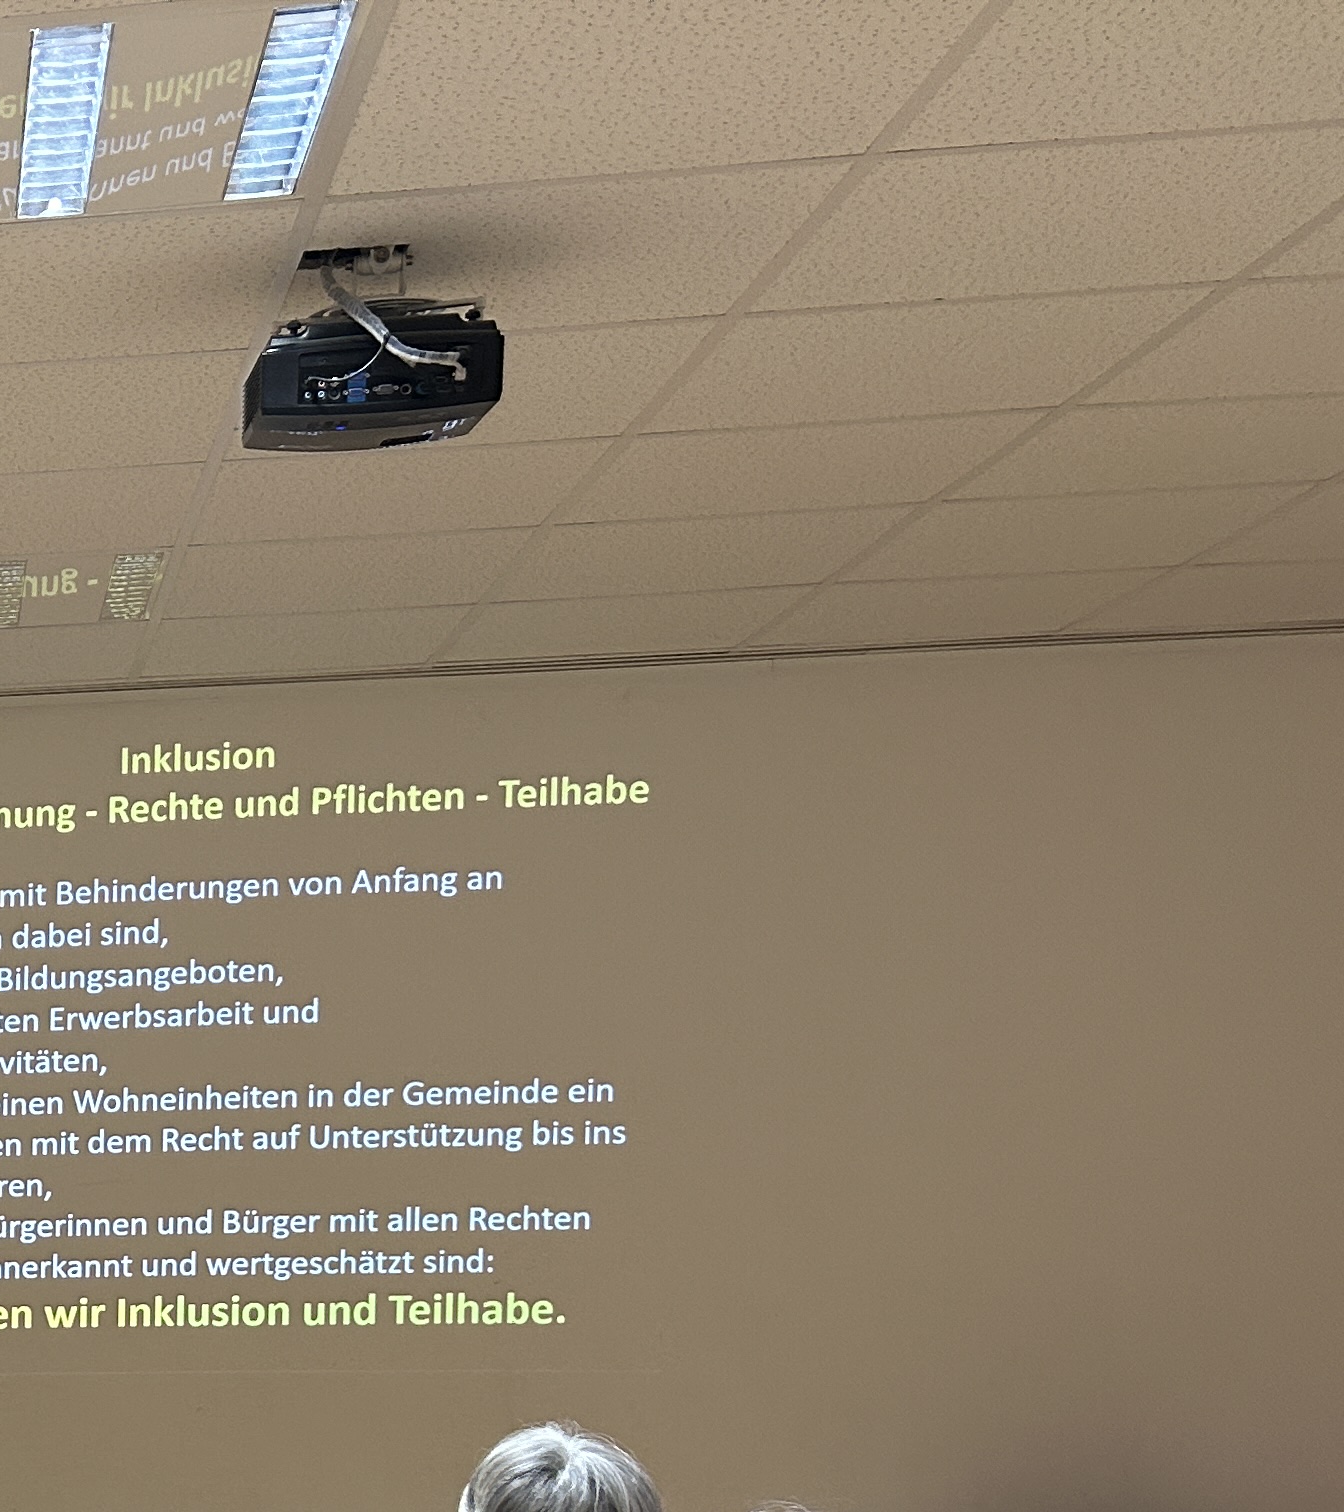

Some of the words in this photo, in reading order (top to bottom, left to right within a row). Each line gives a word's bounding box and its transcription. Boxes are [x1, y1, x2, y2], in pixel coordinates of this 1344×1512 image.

[121, 741, 276, 775] Inklusion
[108, 791, 224, 824] Rechte
[234, 786, 300, 819] und
[311, 782, 465, 816] Pflichten
[497, 773, 650, 809] Teilhabe
[0, 882, 48, 908] mit
[56, 875, 279, 906] Behinderungen
[287, 875, 342, 897] von
[350, 866, 459, 898] Anfang
[466, 870, 503, 891] an
[11, 921, 92, 950] dabei
[100, 917, 169, 949] sind,
[49, 1000, 255, 1032] Erwerbsarbeit
[263, 996, 320, 1025] und
[72, 1084, 298, 1114] Wohneinheiten
[308, 1083, 334, 1109] in
[343, 1080, 395, 1108] der
[402, 1077, 560, 1106] Gemeinde
[568, 1078, 614, 1104] ein
[31, 1131, 80, 1157] mit
[87, 1128, 152, 1155] dem
[162, 1125, 245, 1153] Recht
[252, 1123, 302, 1151] auf
[309, 1122, 524, 1153] Unterstützung
[532, 1119, 575, 1146] bis
[584, 1120, 627, 1146] ins
[157, 1208, 213, 1236] und
[223, 1209, 322, 1240] Bürger
[329, 1208, 379, 1233] mit
[387, 1205, 458, 1233] allen
[469, 1204, 591, 1232] Rechten
[142, 1250, 197, 1277] und
[205, 1248, 416, 1281] wertgeschätzt
[422, 1247, 494, 1274] sind:
[43, 1297, 107, 1329] wir
[117, 1294, 290, 1328] Inklusion
[303, 1292, 377, 1327] und
[387, 1291, 566, 1326] Teilhabe.
